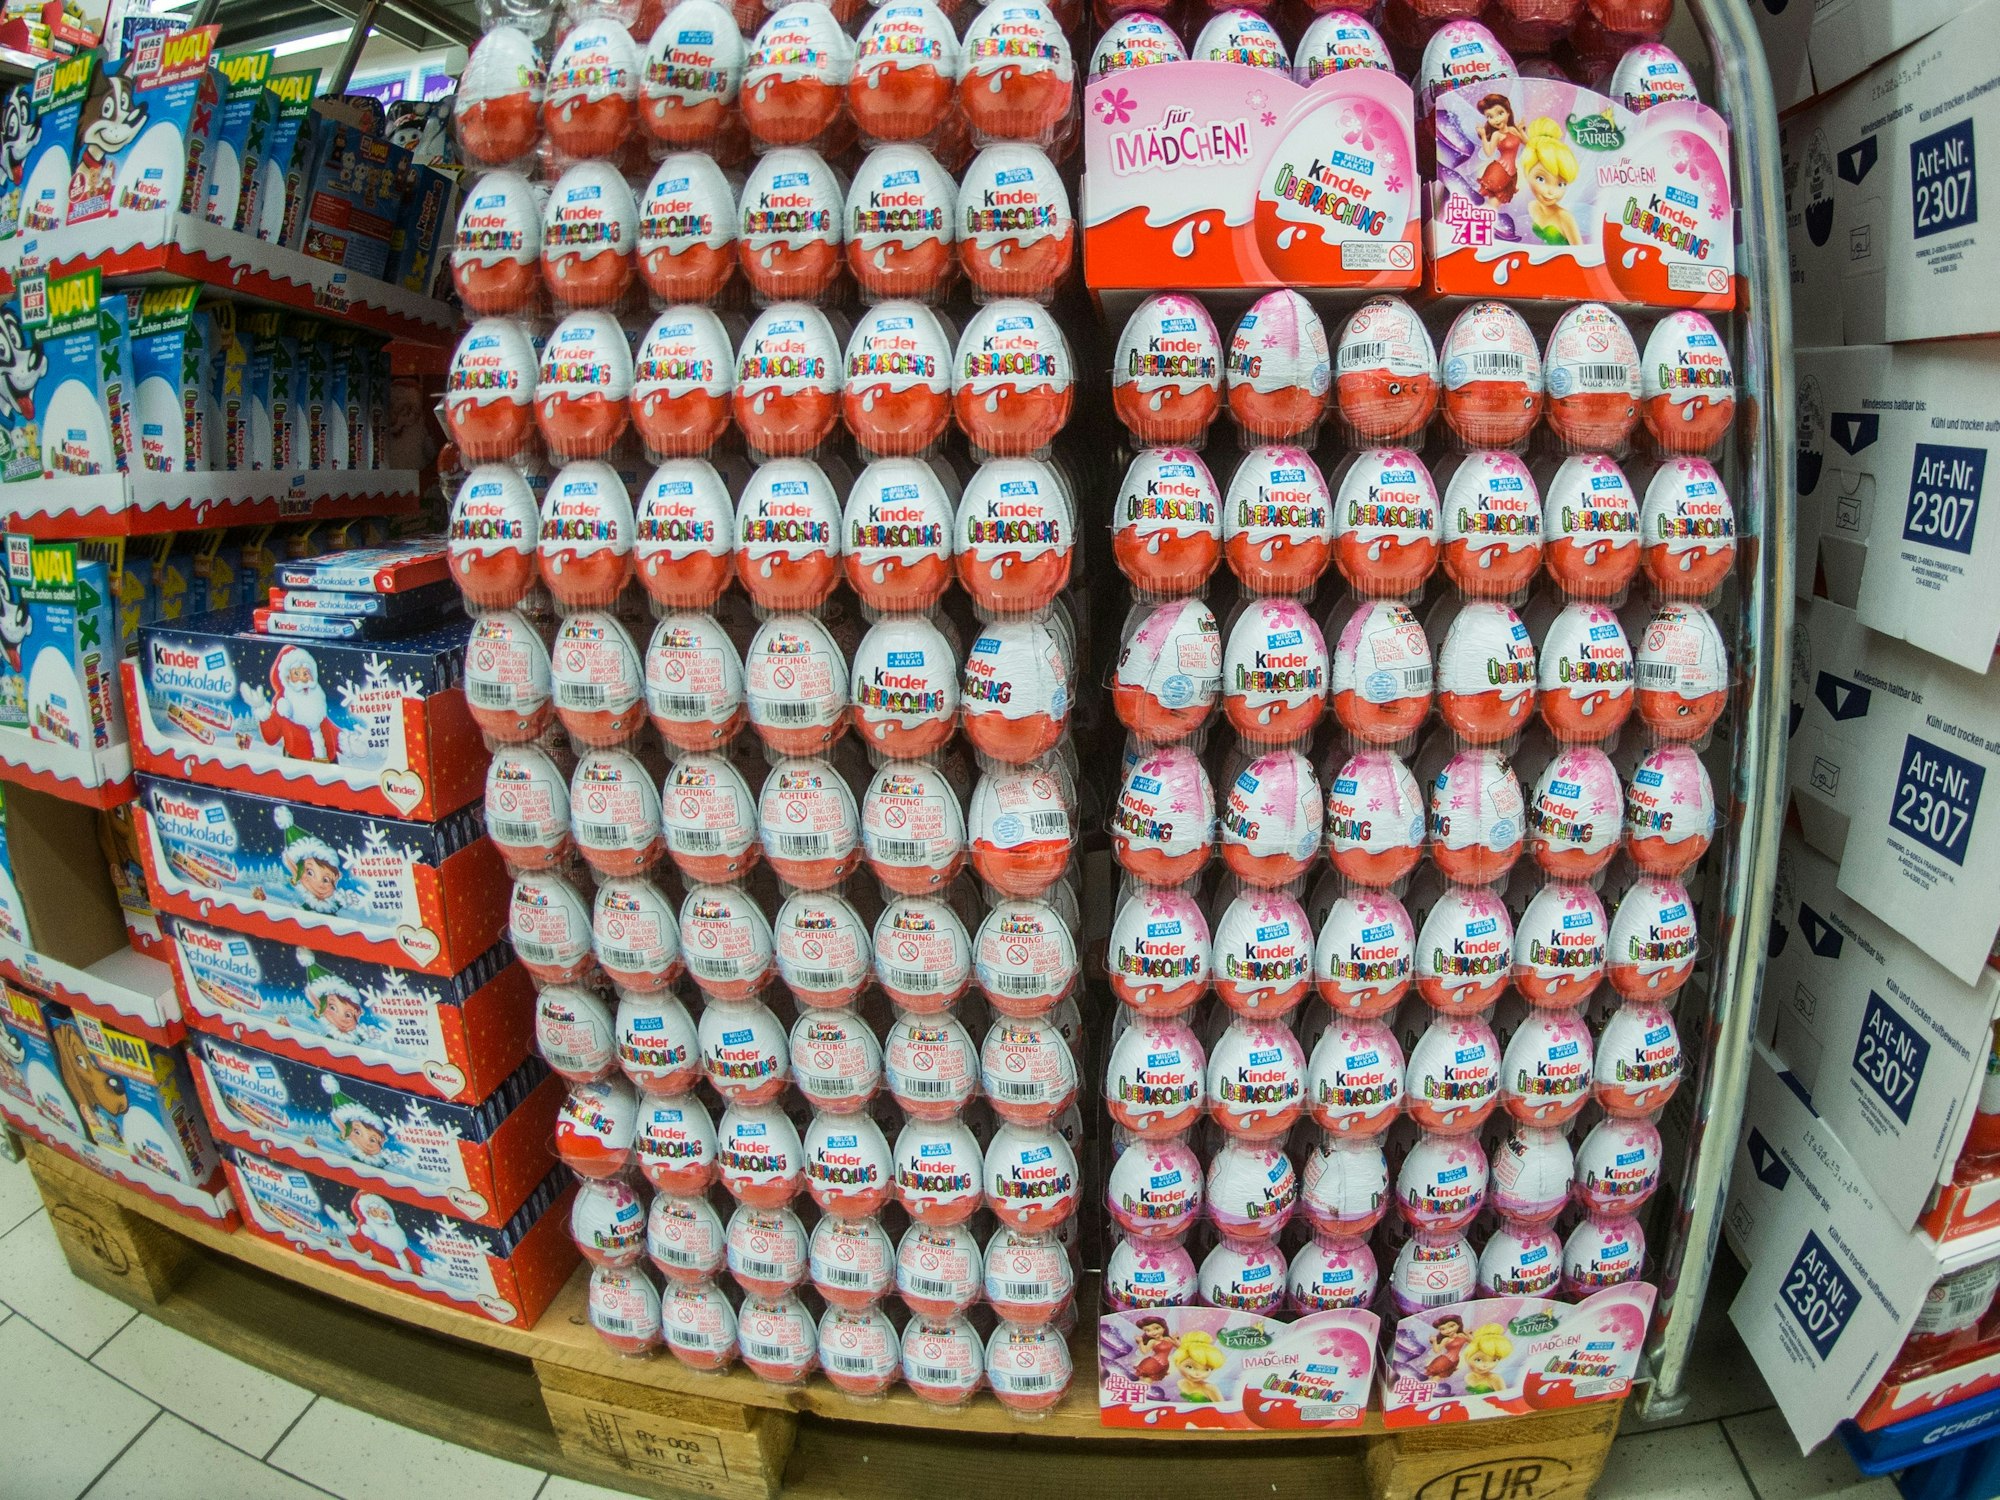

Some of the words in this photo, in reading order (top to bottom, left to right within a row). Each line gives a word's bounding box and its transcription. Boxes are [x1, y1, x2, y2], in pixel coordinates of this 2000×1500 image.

[140, 37, 161, 49] WAS
[164, 30, 211, 68] WAU
[663, 44, 715, 67] kinder
[54, 56, 92, 94] WAU
[218, 53, 270, 82] WAU
[266, 75, 313, 101] WAU
[1163, 108, 1191, 130] für
[1587, 120, 1609, 130] Disney
[1116, 123, 1248, 170] MÄDCHEN!
[1574, 128, 1619, 147] FAIRIES
[1340, 161, 1371, 174] KAKAO
[1344, 154, 1371, 166] MILCH
[1620, 157, 1631, 167] für
[1917, 138, 1969, 181] Art-Nr.
[1308, 159, 1372, 201] kinder
[1600, 165, 1656, 184] MÄDCHEN!
[870, 190, 925, 208] kinder
[984, 189, 1038, 208] kinder
[1275, 163, 1384, 235] ÜBERRASCHUNG
[1452, 195, 1468, 208] in
[1917, 170, 1971, 228] 2307
[1447, 205, 1495, 225] jedem
[1649, 194, 1698, 231] kinder
[1623, 197, 1709, 260] ÜBERRASCHUNG
[23, 282, 43, 294] WAS
[47, 275, 96, 317] WAU
[25, 295, 43, 306] IST
[143, 286, 196, 317] WAU
[24, 307, 44, 319] WAS
[163, 314, 188, 330] schlau!
[863, 335, 917, 350] kinder
[1148, 335, 1202, 353] kinder
[1862, 399, 1893, 410] Mindestens
[1894, 400, 1914, 410] haltbar
[1915, 400, 1926, 411] bis:
[1931, 417, 1946, 429] Kühl
[1947, 419, 1959, 429] und
[1960, 420, 1984, 431] trocken
[1917, 457, 1974, 491] Art-Nr.
[1258, 485, 1312, 503] kinder
[1581, 492, 1629, 510] kinder
[552, 499, 600, 518] kinder
[869, 504, 925, 523] kinder
[987, 500, 1044, 518] kinder
[1908, 491, 1974, 541] 2307
[10, 541, 28, 551] WAS
[12, 565, 29, 577] WAS
[32, 550, 73, 584] WAU
[283, 573, 310, 585] kinder
[311, 575, 356, 587] Schokolade
[292, 597, 317, 608] kinder
[318, 599, 362, 611] Schokolade
[274, 620, 298, 631] kinder
[299, 622, 341, 634] Schokolade
[154, 643, 199, 669] kinder
[896, 652, 921, 660] MILCH
[1255, 651, 1308, 669] kinder
[1580, 642, 1625, 660] kinder
[894, 659, 923, 667] KAKAO
[155, 669, 232, 693] Schokolade
[874, 667, 929, 690] kinder
[1854, 669, 1887, 692] Mindestens
[1888, 683, 1911, 700] haltbar
[1911, 691, 1923, 705] bis:
[1926, 714, 1942, 730] Kühl
[1943, 722, 1956, 736] und
[1957, 727, 1984, 748] trocken
[1907, 751, 1970, 805] Art-Nr.
[386, 782, 416, 796] kinder
[153, 797, 200, 821] kinder
[1896, 783, 1968, 848] 2307
[157, 816, 234, 847] Schokolade
[177, 923, 222, 952] kinder
[402, 937, 432, 950] kinder
[1135, 937, 1186, 956] kinder
[1550, 930, 1597, 946] kinder
[1876, 953, 1885, 966] bis:
[1886, 977, 1900, 996] Kühl
[1899, 990, 1911, 1006] und
[1910, 999, 1932, 1026] trocken
[1931, 1020, 1971, 1062] aufbewahren.
[626, 1029, 669, 1048] kinder
[1868, 1007, 1917, 1073] Art-Nr.
[205, 1045, 252, 1073] kinder
[429, 1071, 458, 1085] kinder
[1238, 1067, 1286, 1084] kinder
[1444, 1064, 1490, 1080] kinder
[1858, 1034, 1915, 1106] 2307
[210, 1063, 284, 1100] Schokolade
[237, 1150, 283, 1182] kinder
[1012, 1165, 1057, 1180] kinder
[1140, 1188, 1185, 1203] kinder
[1821, 1199, 1831, 1213] bis:
[1802, 1248, 1847, 1317] Art-Nr.
[1828, 1224, 1841, 1245] Kühl
[1840, 1239, 1851, 1257] und
[1848, 1250, 1869, 1281] trocken
[1867, 1276, 1900, 1325] aufbewahren.
[1786, 1268, 1840, 1342] 2307
[1516, 1321, 1554, 1335] FAIRIES
[1225, 1335, 1267, 1346] FAIRIES
[1545, 1358, 1617, 1377] ÜBERRASCHUNG
[1106, 1381, 1149, 1392] jedem
[1112, 1373, 1126, 1383] in
[1289, 1369, 1335, 1388] kinder
[1395, 1381, 1437, 1394] jedem
[1263, 1374, 1345, 1403] ÜBERRASCHUNG
[1451, 1464, 1542, 1500] EUR
